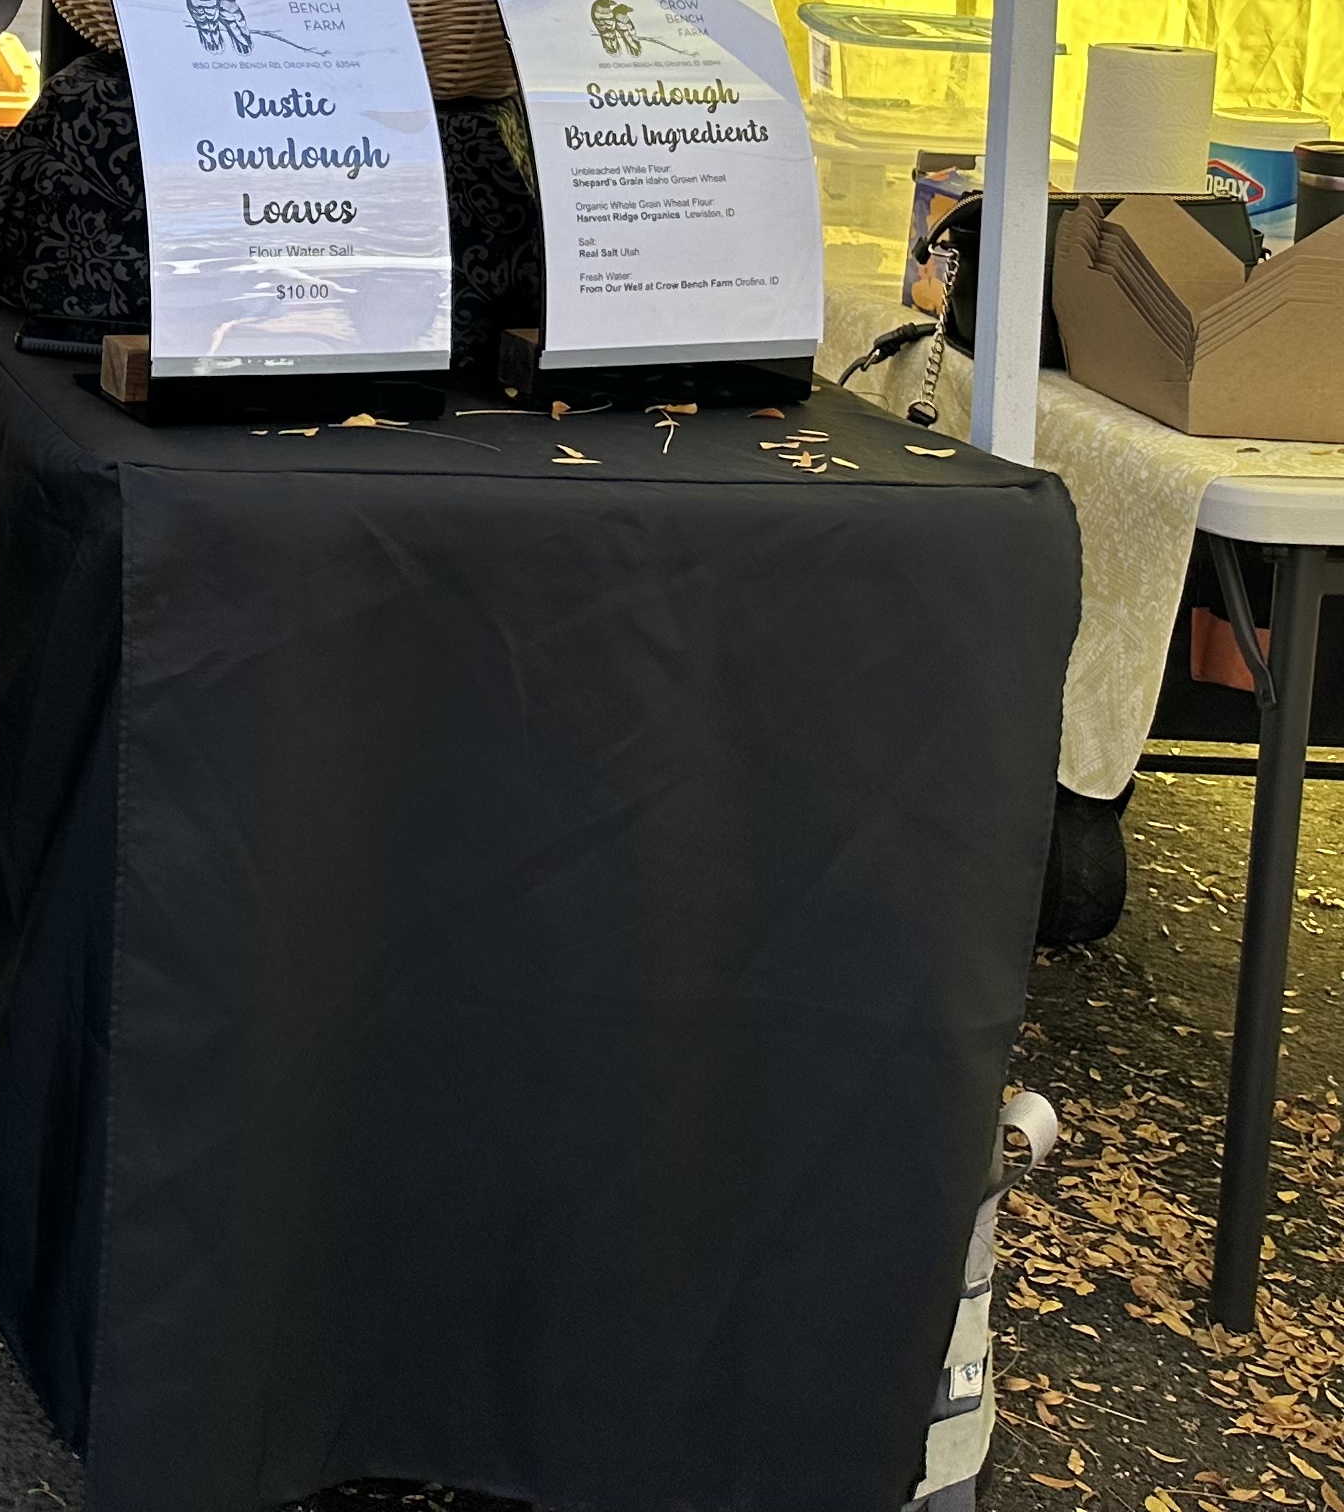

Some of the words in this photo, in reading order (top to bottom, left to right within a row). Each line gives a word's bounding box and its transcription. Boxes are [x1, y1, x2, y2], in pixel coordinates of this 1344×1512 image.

[288, 1, 341, 14] BENCH
[660, 0, 698, 10] CROW
[304, 19, 345, 31] FARM
[665, 13, 704, 24] BENCH
[678, 27, 709, 37] FARM
[212, 61, 238, 70] CROW
[239, 61, 267, 69] BENCH
[586, 78, 740, 114] Sourdough
[234, 88, 336, 119] Rustic
[565, 124, 638, 149] Bread
[642, 119, 769, 153] Ingredients
[196, 136, 390, 180] Sourdough
[571, 166, 620, 176] Unbleached
[572, 178, 617, 188] Shepard's
[619, 177, 643, 186] Grain
[646, 176, 669, 185] Idaho
[700, 174, 727, 183] Wheat
[242, 193, 357, 226] Loaves
[576, 201, 609, 212] Organic
[610, 201, 637, 210] Whole
[639, 199, 661, 209] Grain
[663, 198, 690, 208] Wheat
[577, 213, 611, 223] Harvest
[613, 212, 639, 223] Ridge
[641, 211, 680, 222] Organics
[725, 208, 735, 217] ID
[579, 249, 599, 258] Real
[601, 248, 618, 258] Salt
[620, 248, 639, 257] Utah
[580, 273, 604, 282] Fresh
[276, 284, 329, 300] $10.00
[580, 285, 603, 294] From
[605, 284, 622, 293] Our
[624, 283, 642, 292] Well
[645, 283, 654, 291] at
[656, 281, 679, 290] Crow
[681, 280, 708, 289] Bench
[711, 279, 733, 288] Farm
[770, 276, 779, 286] ID
